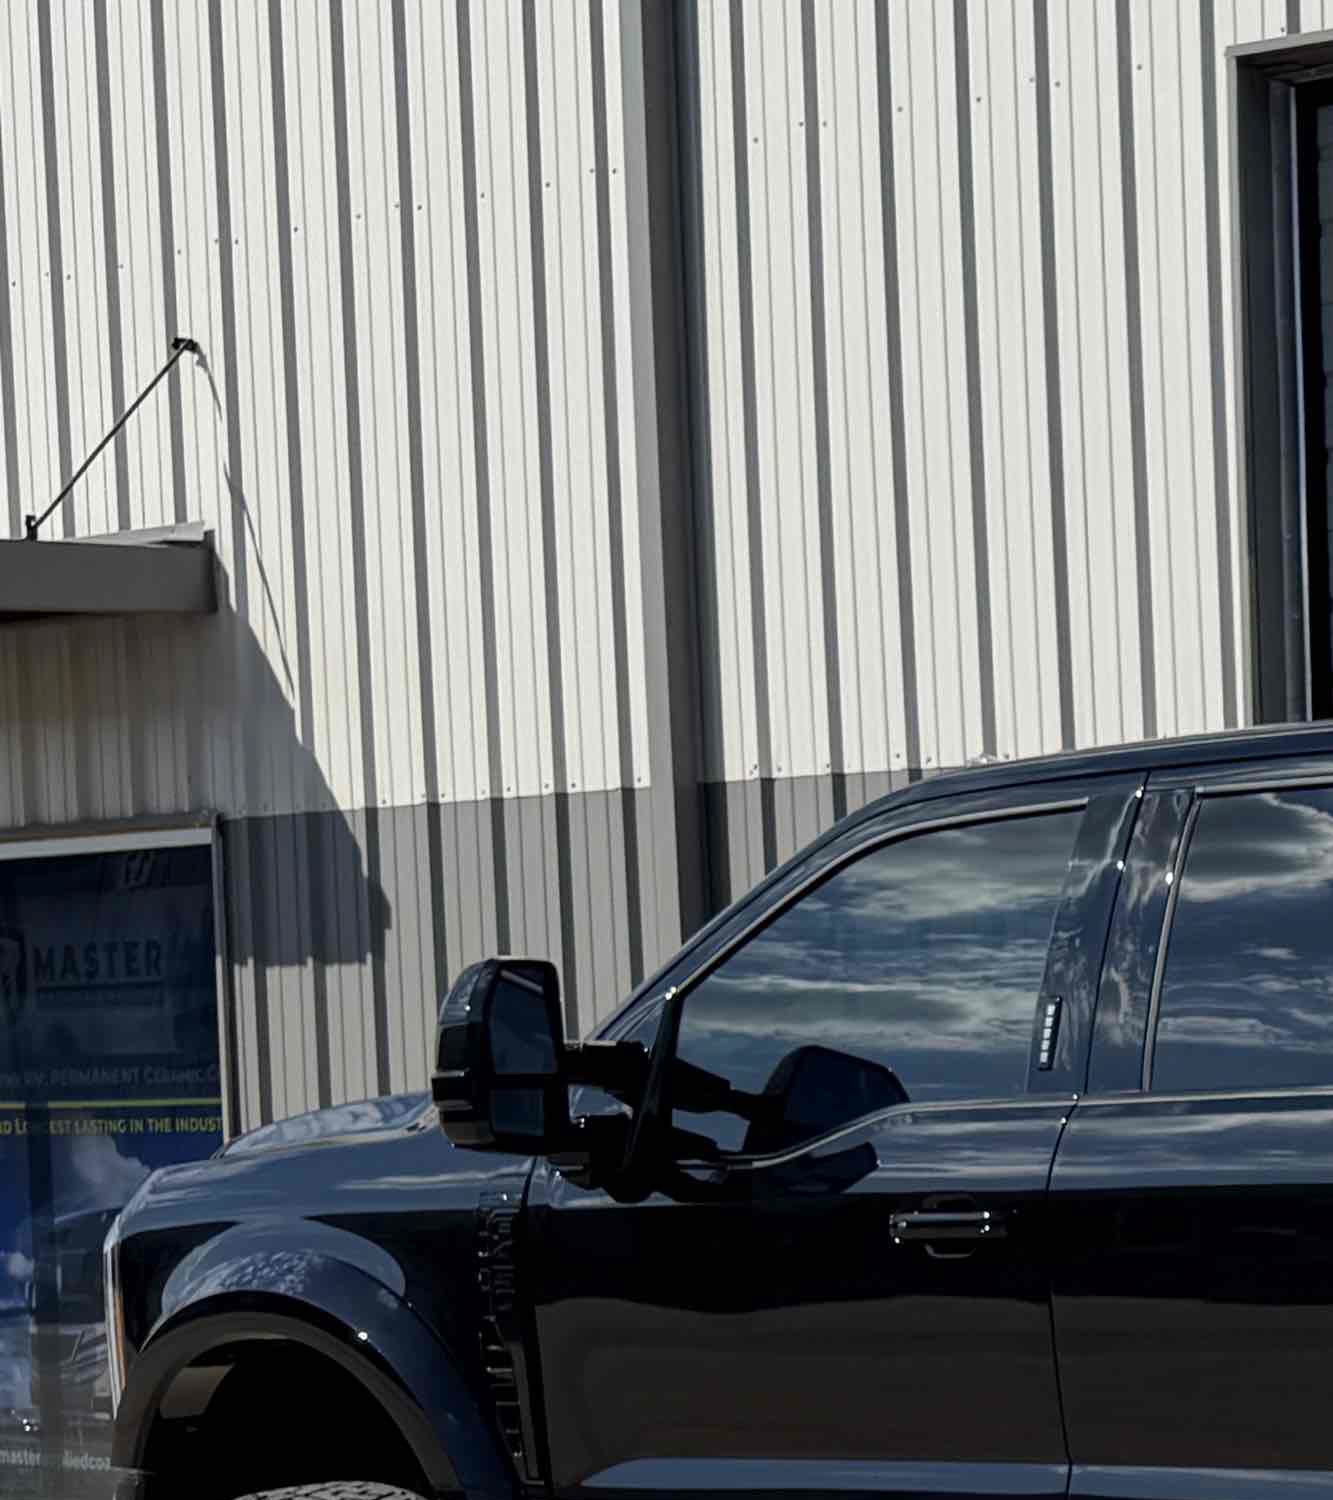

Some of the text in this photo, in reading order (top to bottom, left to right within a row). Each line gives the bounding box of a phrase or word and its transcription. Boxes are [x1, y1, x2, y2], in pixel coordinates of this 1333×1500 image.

[34, 938, 162, 981] MASTER
[129, 1118, 144, 1134] IN
[146, 1117, 173, 1134] THE
